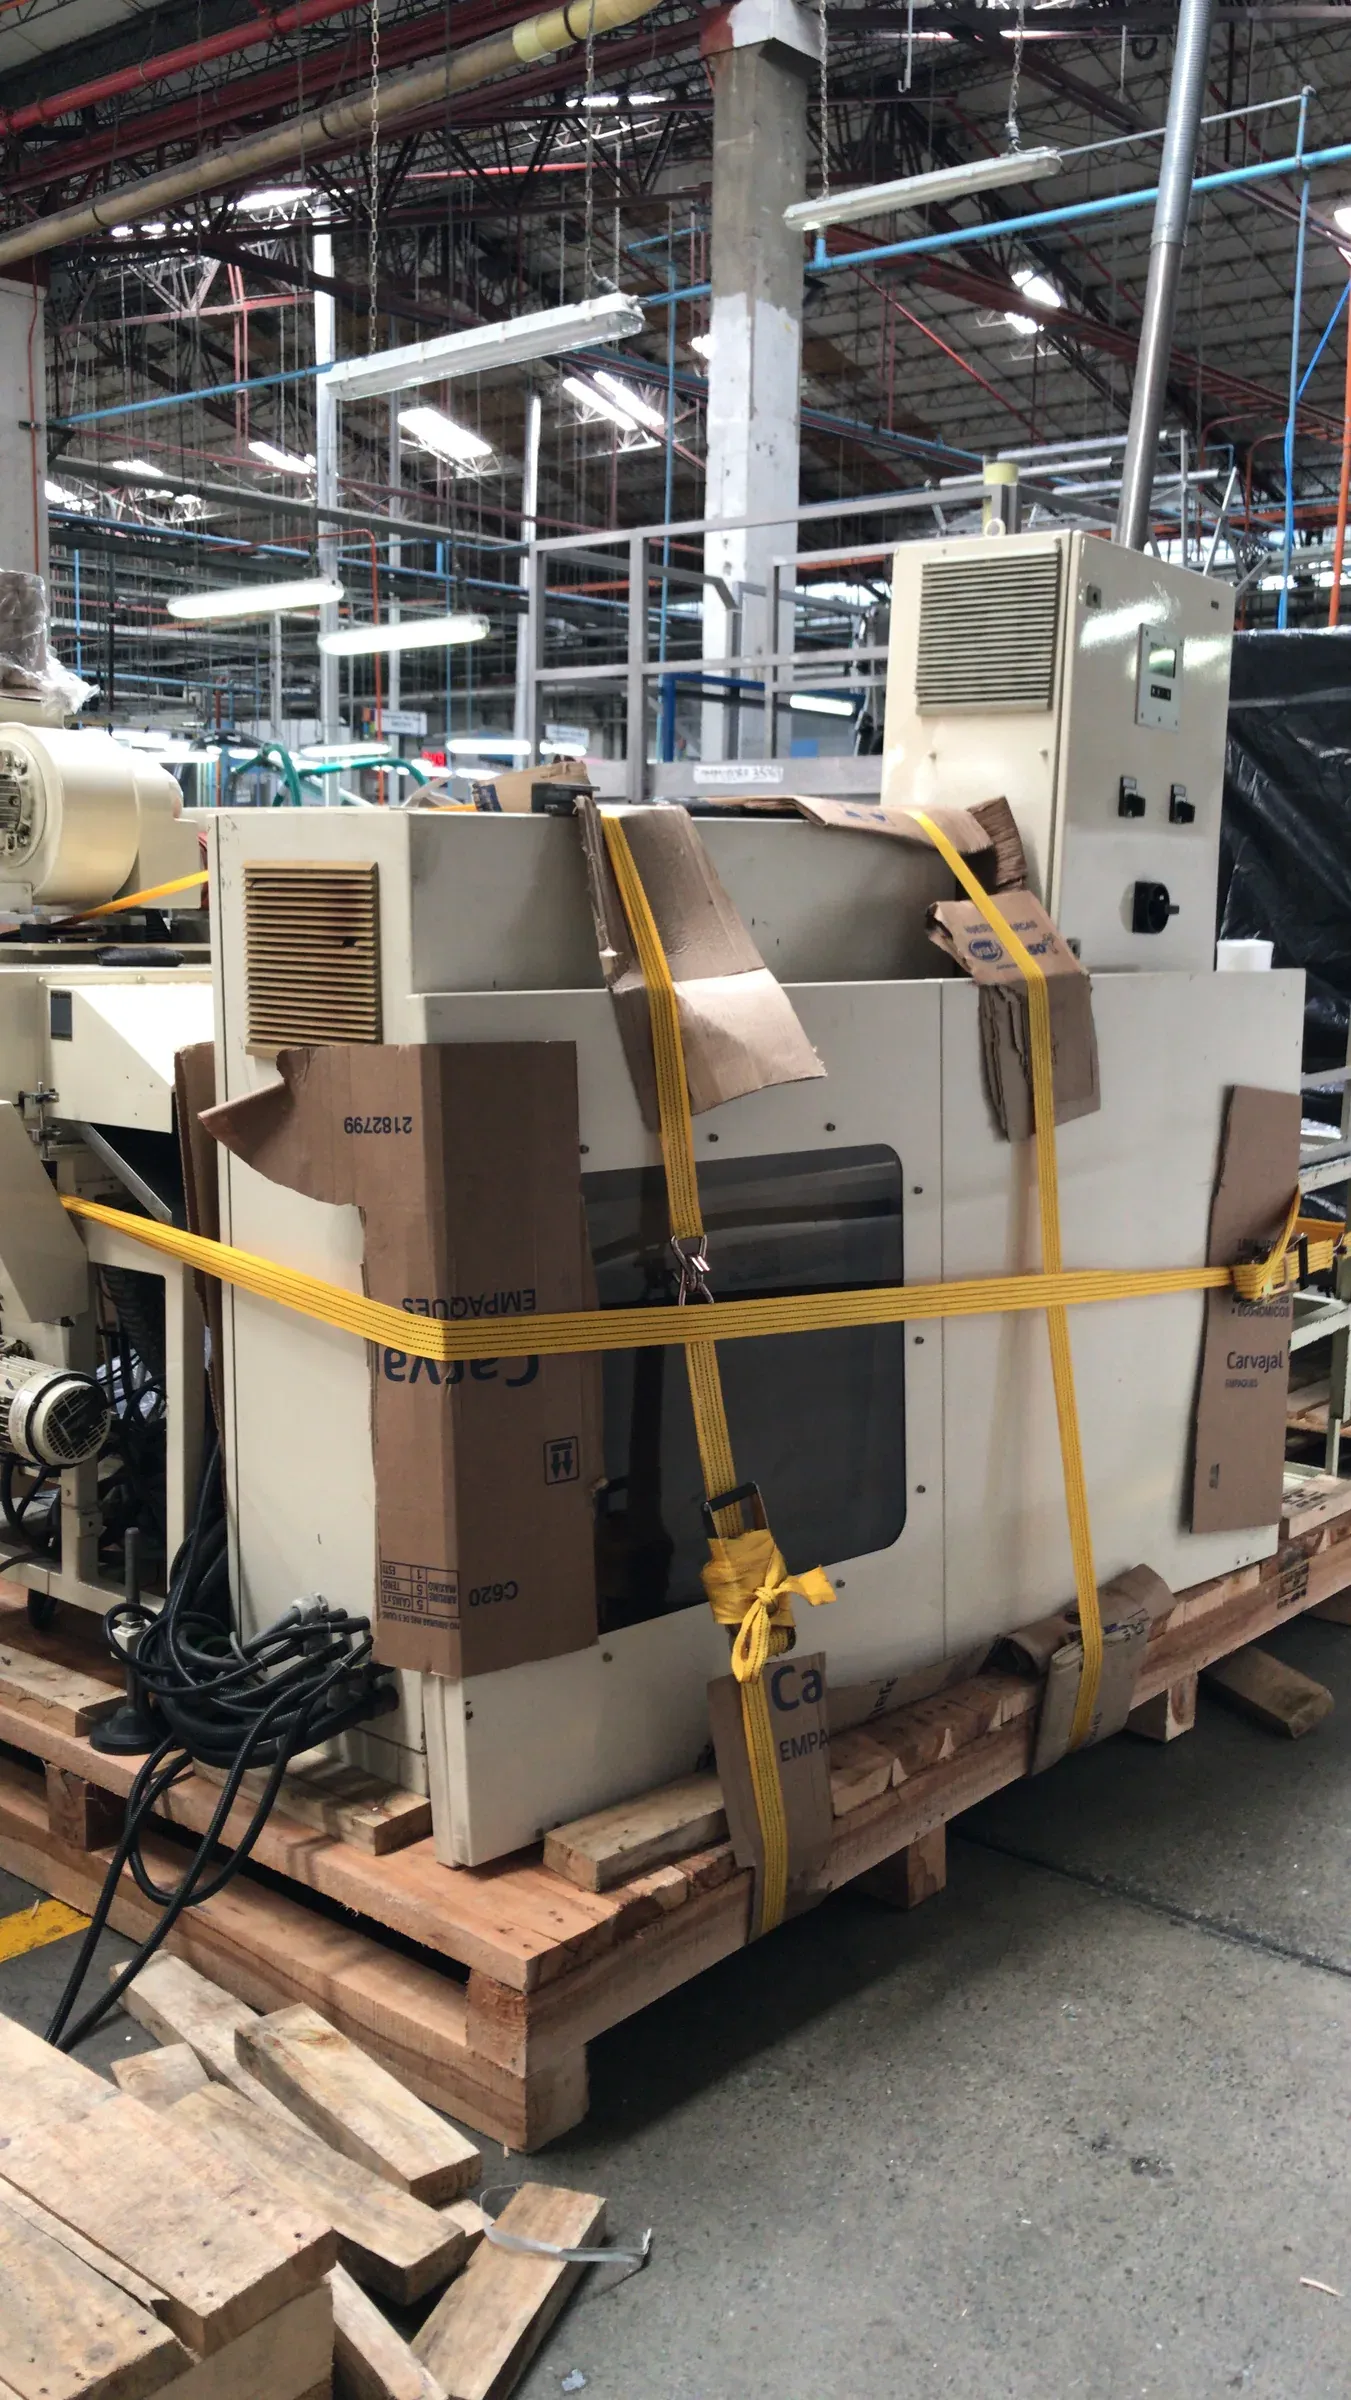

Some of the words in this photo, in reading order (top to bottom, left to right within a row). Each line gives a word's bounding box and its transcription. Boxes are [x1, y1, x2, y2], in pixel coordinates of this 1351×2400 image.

[344, 1116, 412, 1134] 2182799
[402, 1288, 536, 1320] EMPAQUES
[1226, 1351, 1283, 1373] Carvajal
[416, 1569, 423, 1580] 1
[416, 1585, 424, 1595] 5
[468, 1581, 518, 1607] C620
[416, 1599, 424, 1610] 5
[771, 1665, 823, 1711] Ca
[780, 1729, 830, 1762] EMPA
